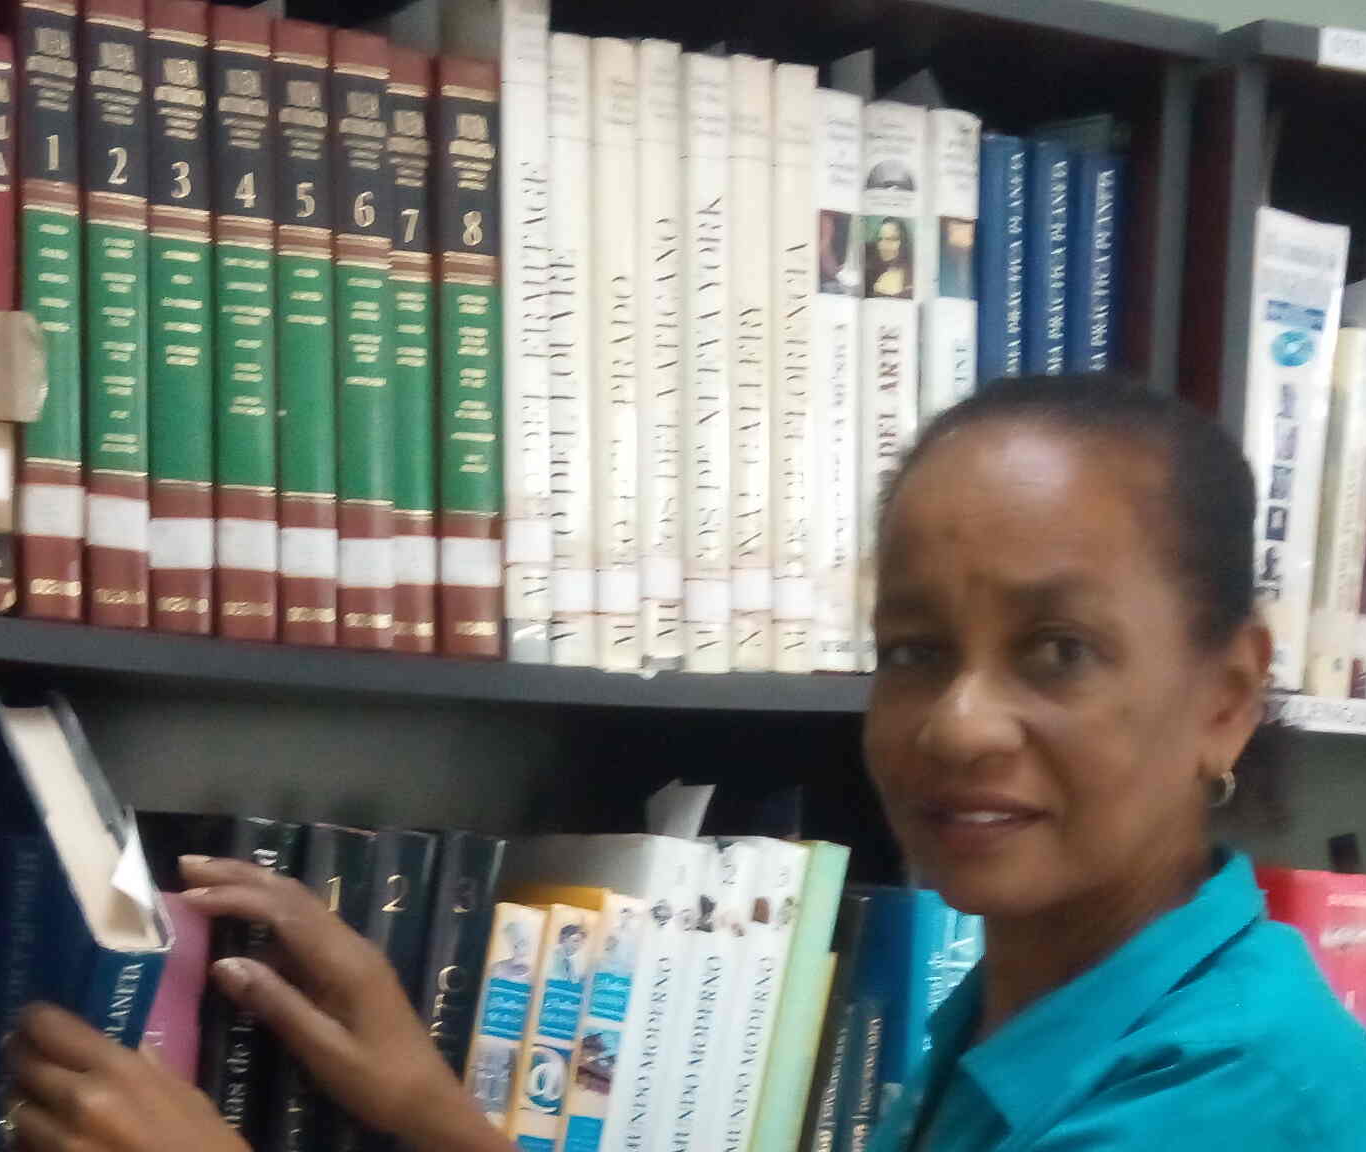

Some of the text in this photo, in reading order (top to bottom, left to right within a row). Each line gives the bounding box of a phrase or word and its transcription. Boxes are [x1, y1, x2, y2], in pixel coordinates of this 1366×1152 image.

[46, 134, 60, 171] 1
[107, 147, 129, 185] 2
[170, 161, 192, 199] 3
[235, 171, 257, 209] 4
[296, 181, 315, 218] 5
[353, 191, 375, 228] 6
[401, 208, 420, 244] 7
[462, 210, 483, 247] 8
[695, 196, 724, 292] YORK
[653, 217, 678, 397] VATICANO
[610, 274, 636, 405] PRADO
[878, 323, 901, 391] ARTE
[325, 875, 343, 912] 1
[381, 874, 409, 912] 2
[639, 957, 671, 1068] MODERNO
[690, 957, 725, 1065] MODERNO
[739, 957, 775, 1064] MODERNO
